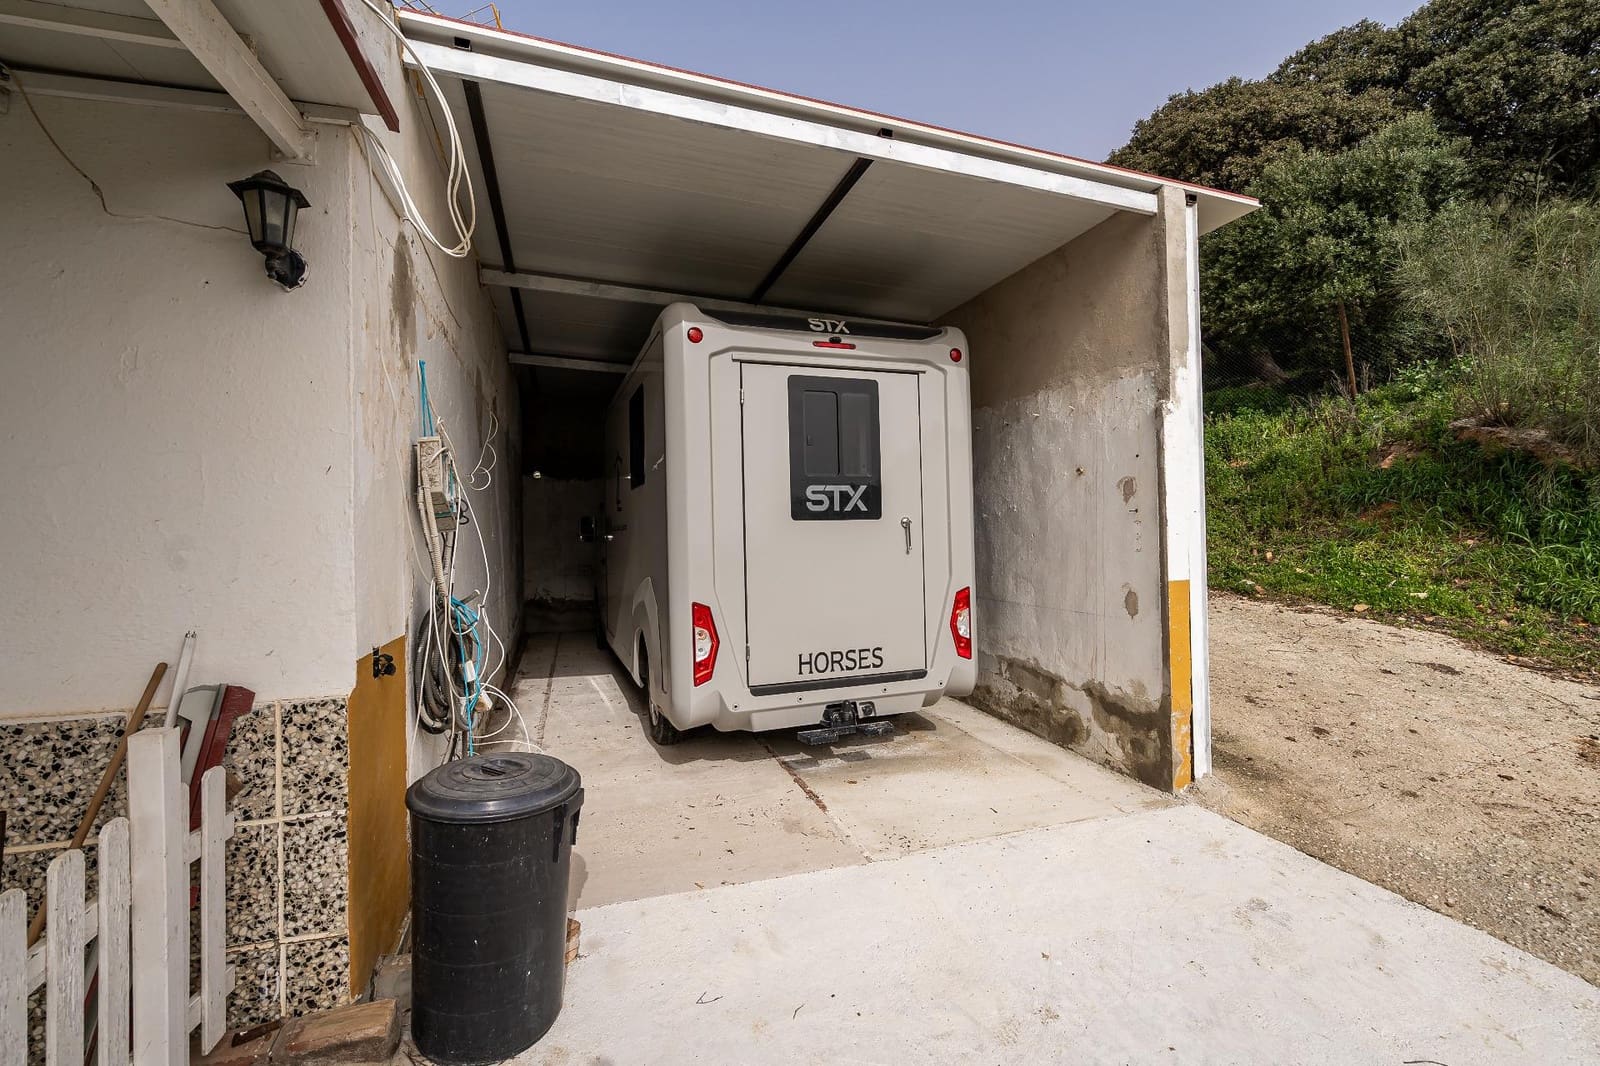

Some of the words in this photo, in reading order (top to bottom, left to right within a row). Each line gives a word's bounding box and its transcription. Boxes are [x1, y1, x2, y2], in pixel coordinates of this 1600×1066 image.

[808, 318, 850, 334] STX
[806, 485, 869, 512] STX
[798, 647, 884, 675] HORSES
